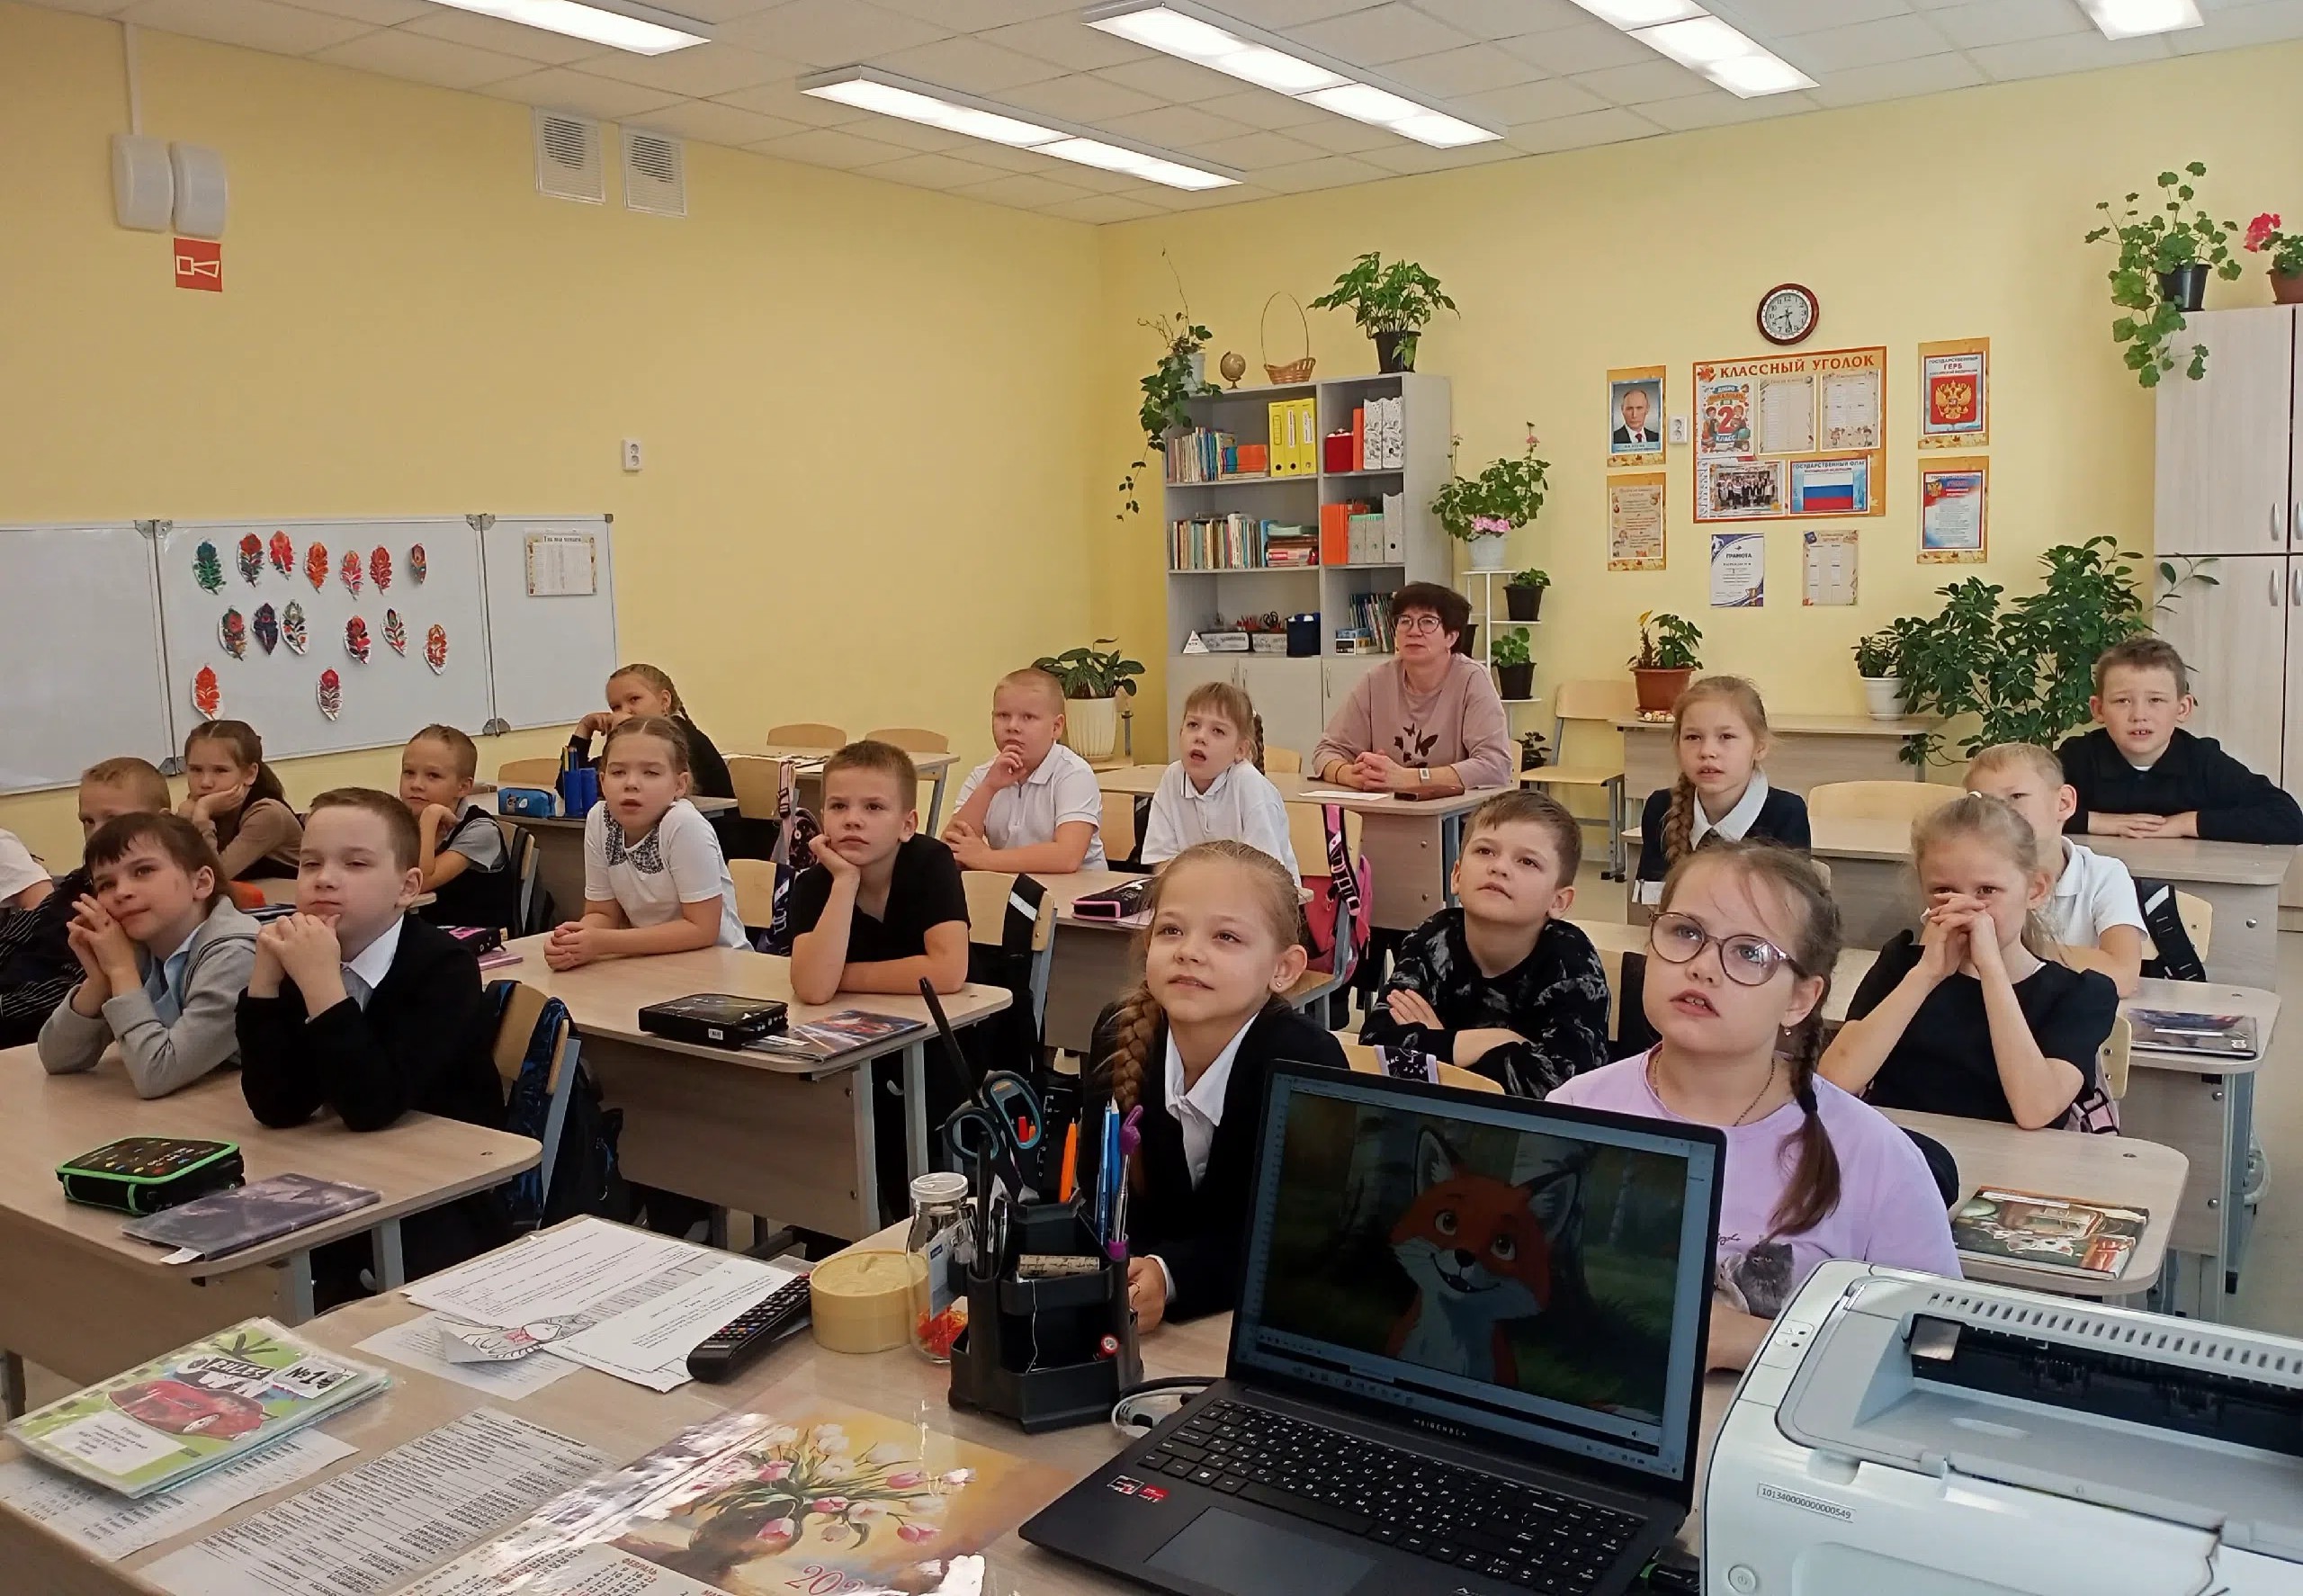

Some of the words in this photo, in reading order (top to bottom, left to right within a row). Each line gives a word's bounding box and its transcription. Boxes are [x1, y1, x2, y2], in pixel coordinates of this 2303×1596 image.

[1720, 359, 1805, 378] КЛАССНЫЙ
[1813, 354, 1874, 371] УГОЛОК
[1718, 406, 1734, 434] 2
[284, 1366, 327, 1385] №1
[612, 1571, 623, 1579] 10
[622, 1557, 658, 1575] ФЕВРАЛЬ
[644, 1575, 657, 1583] 23
